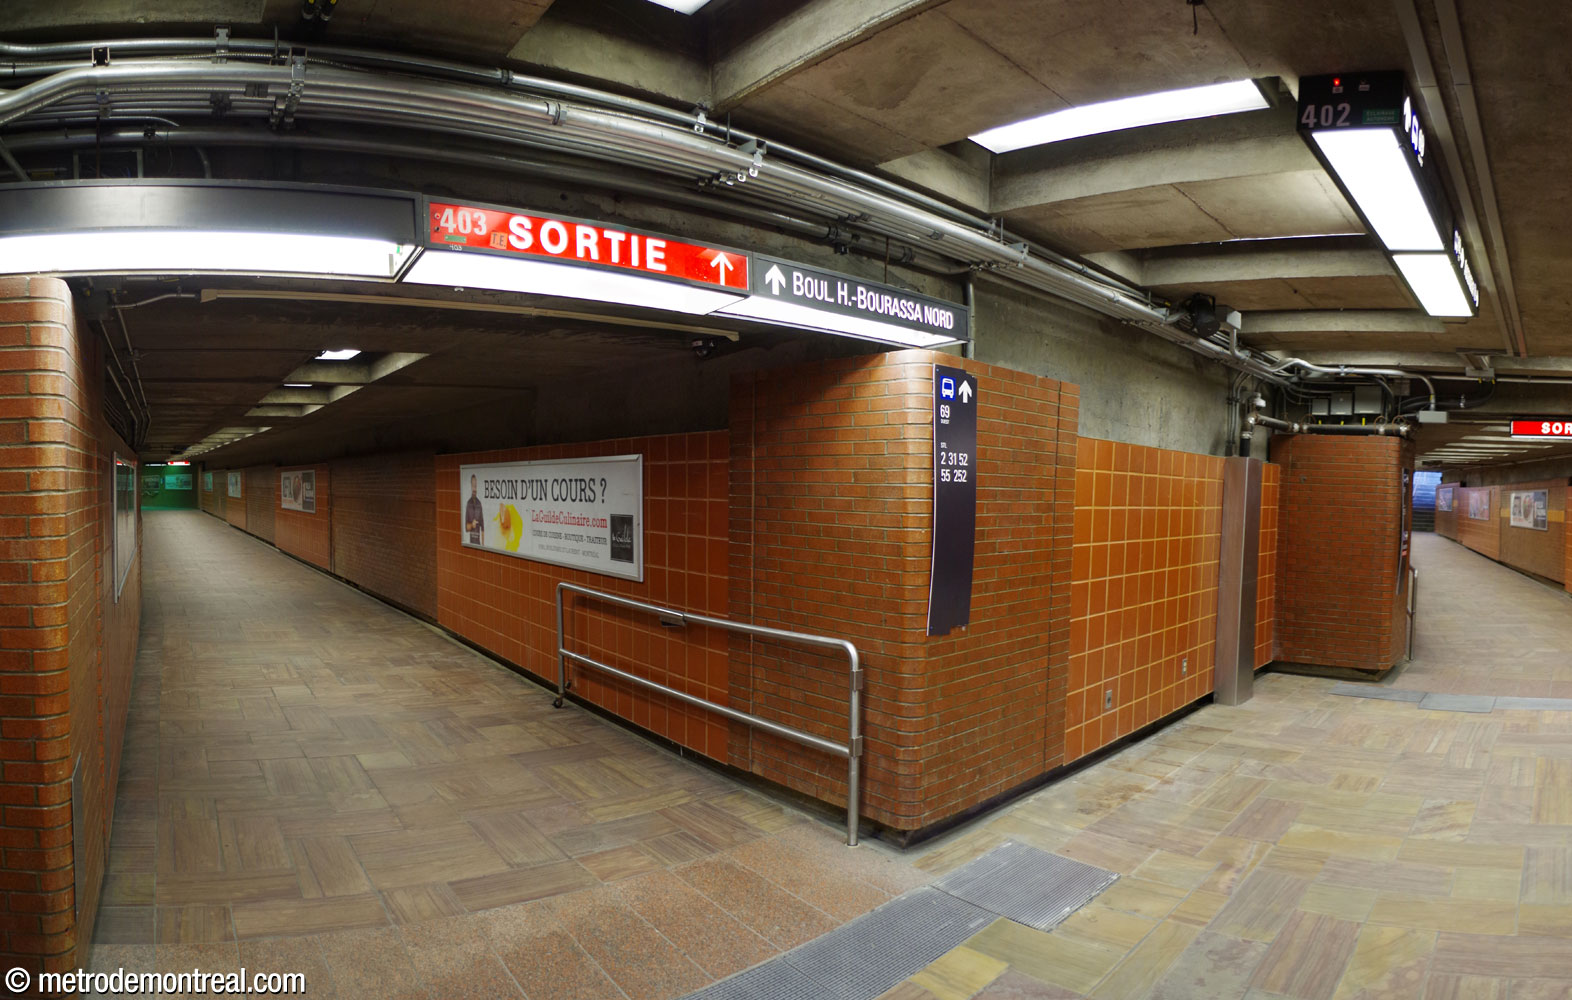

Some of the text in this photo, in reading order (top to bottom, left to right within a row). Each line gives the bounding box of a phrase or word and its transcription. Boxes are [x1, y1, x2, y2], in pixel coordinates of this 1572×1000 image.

[1301, 103, 1350, 128] 402
[440, 208, 667, 272] 403 SORTIE
[792, 271, 954, 330] BOUL H.-BOURASSA NORD
[940, 405, 950, 418] 69
[940, 452, 968, 466] 2 31 52
[941, 469, 967, 482] 55 252
[484, 479, 518, 500] BESOIN
[521, 479, 548, 501] D'UN
[551, 478, 596, 503] COURS
[531, 509, 608, 528] LaGuildeCulinaire.com
